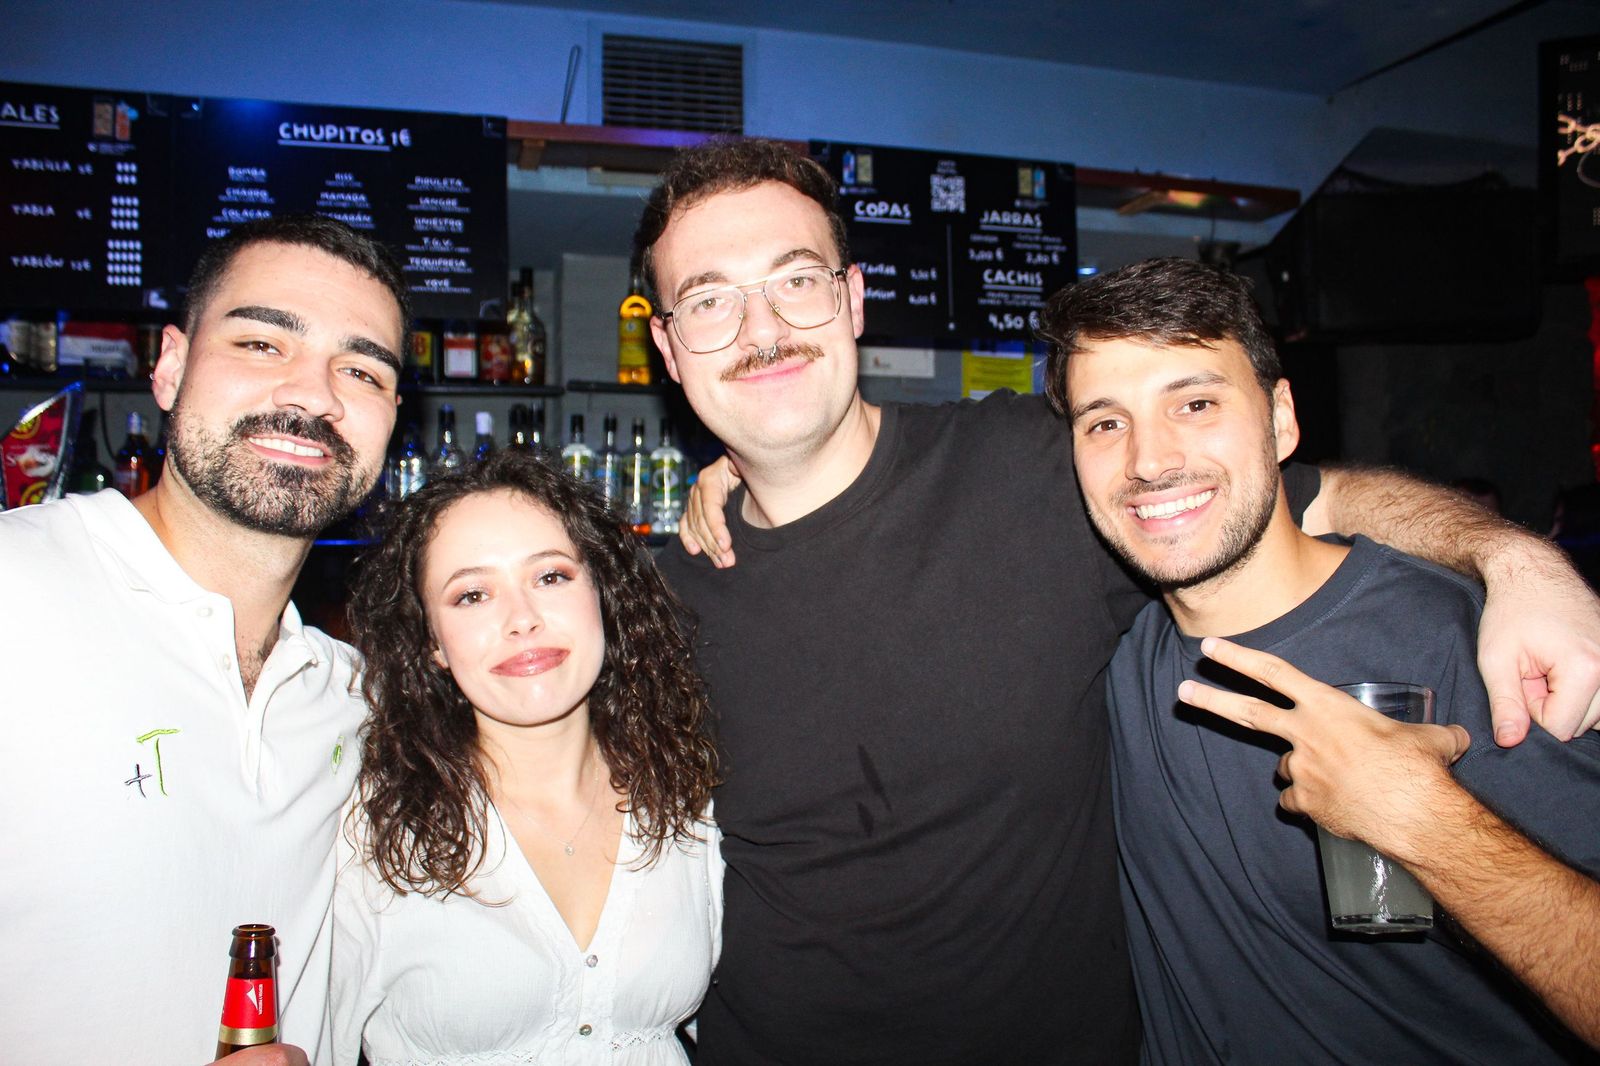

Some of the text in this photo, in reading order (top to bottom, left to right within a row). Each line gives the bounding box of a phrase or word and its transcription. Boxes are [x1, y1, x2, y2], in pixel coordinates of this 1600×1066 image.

[0, 102, 60, 122] ALES
[278, 122, 385, 144] CHUPITOS
[11, 204, 55, 217] TABLA
[854, 200, 911, 219] COPAS
[980, 210, 1042, 228] JARRAS
[983, 269, 1043, 287] CACHIS
